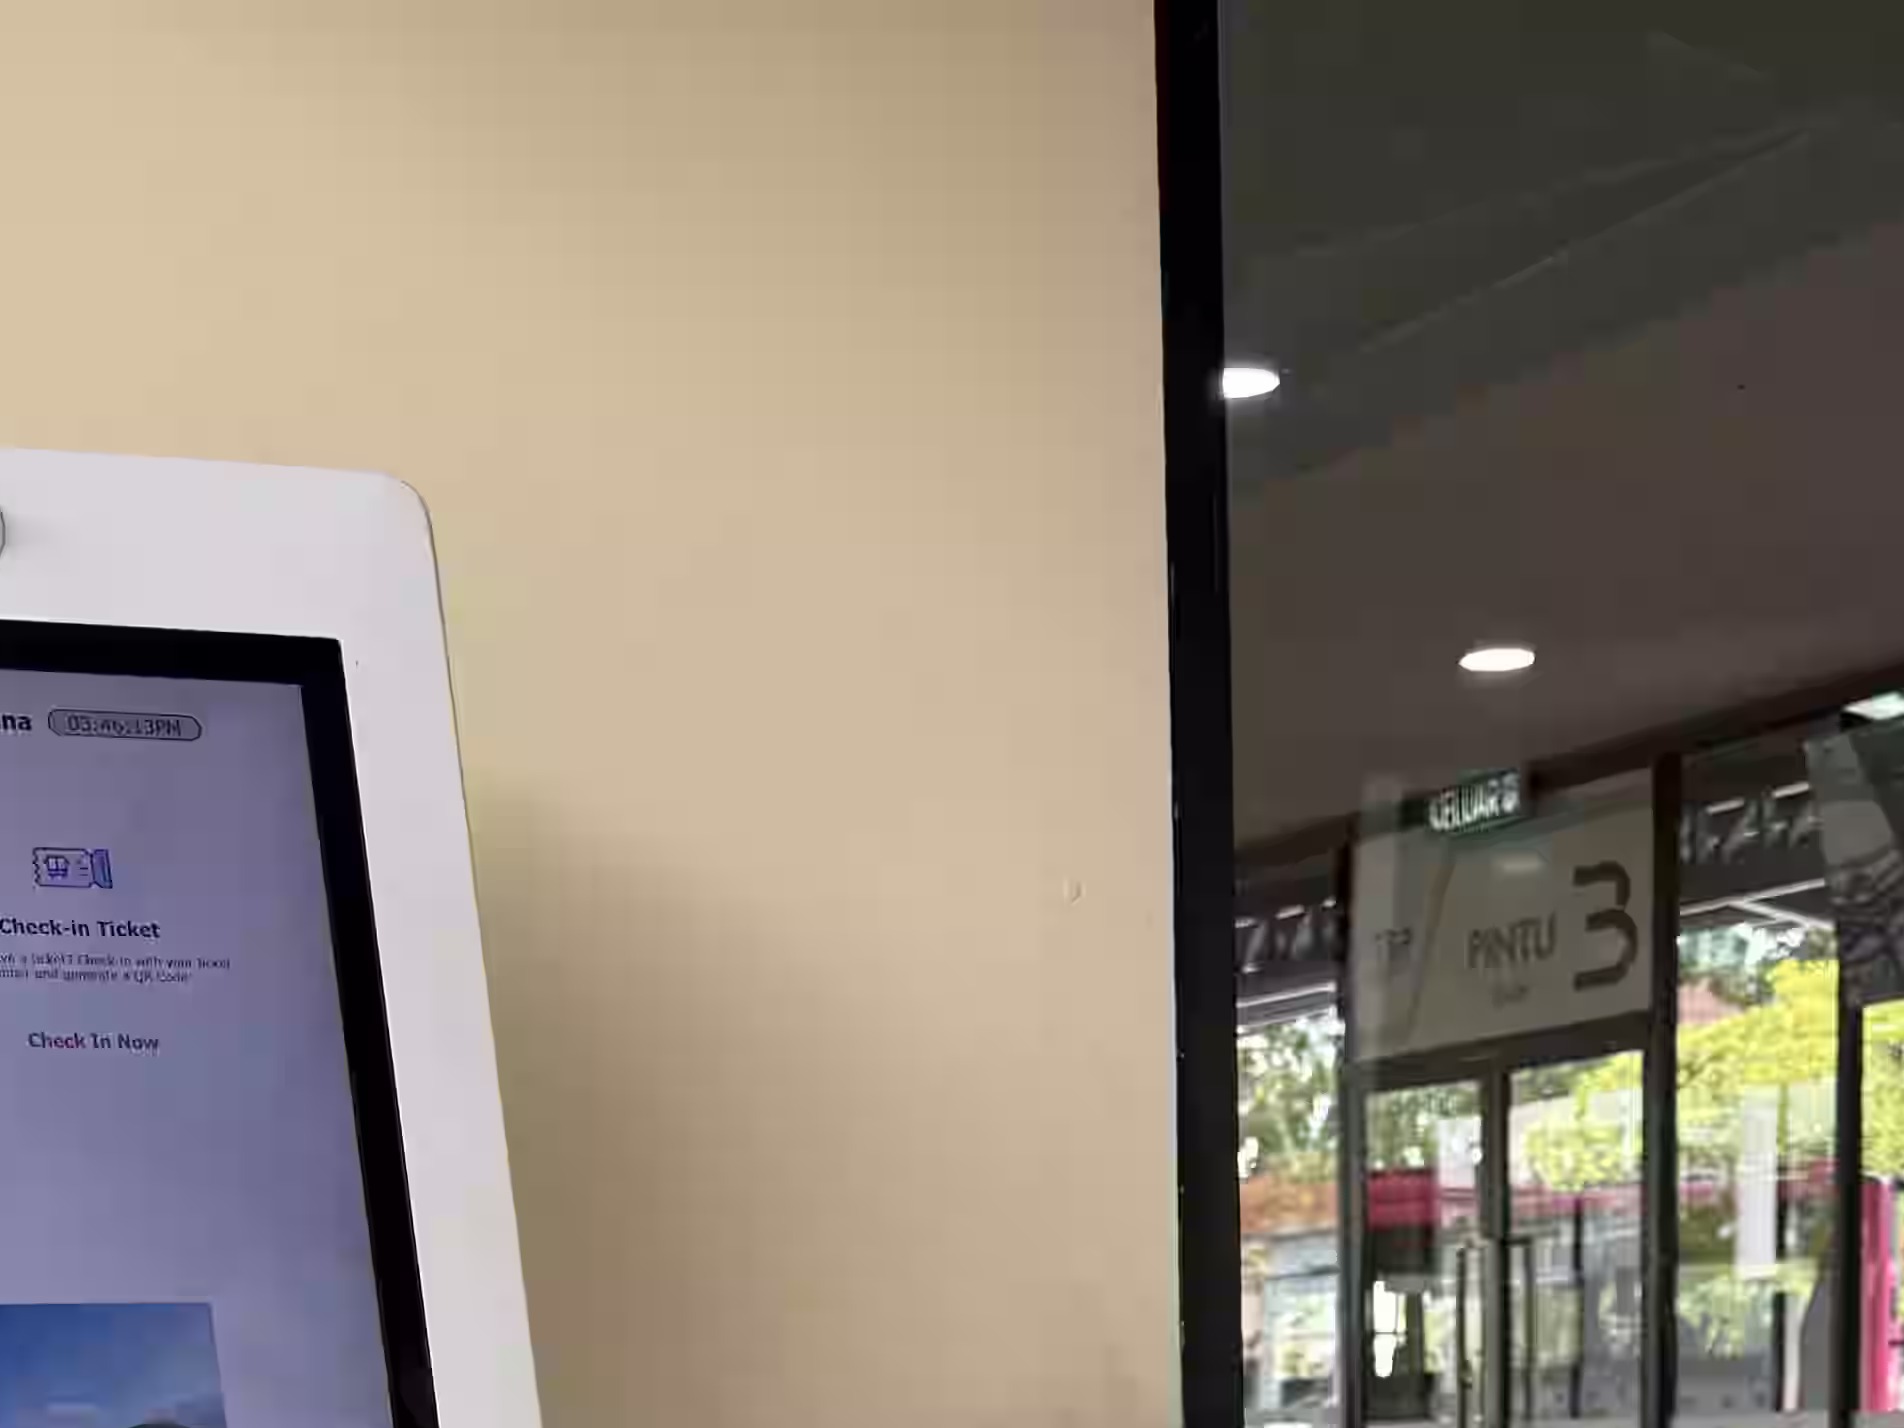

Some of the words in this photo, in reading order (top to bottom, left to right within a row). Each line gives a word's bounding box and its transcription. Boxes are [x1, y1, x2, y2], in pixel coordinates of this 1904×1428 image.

[97, 920, 160, 938] Ticket
[1469, 911, 1557, 969] PINTU
[1572, 861, 1639, 992] 3
[27, 1031, 86, 1049] Check
[90, 1033, 111, 1049] In
[118, 1034, 160, 1052] Now
